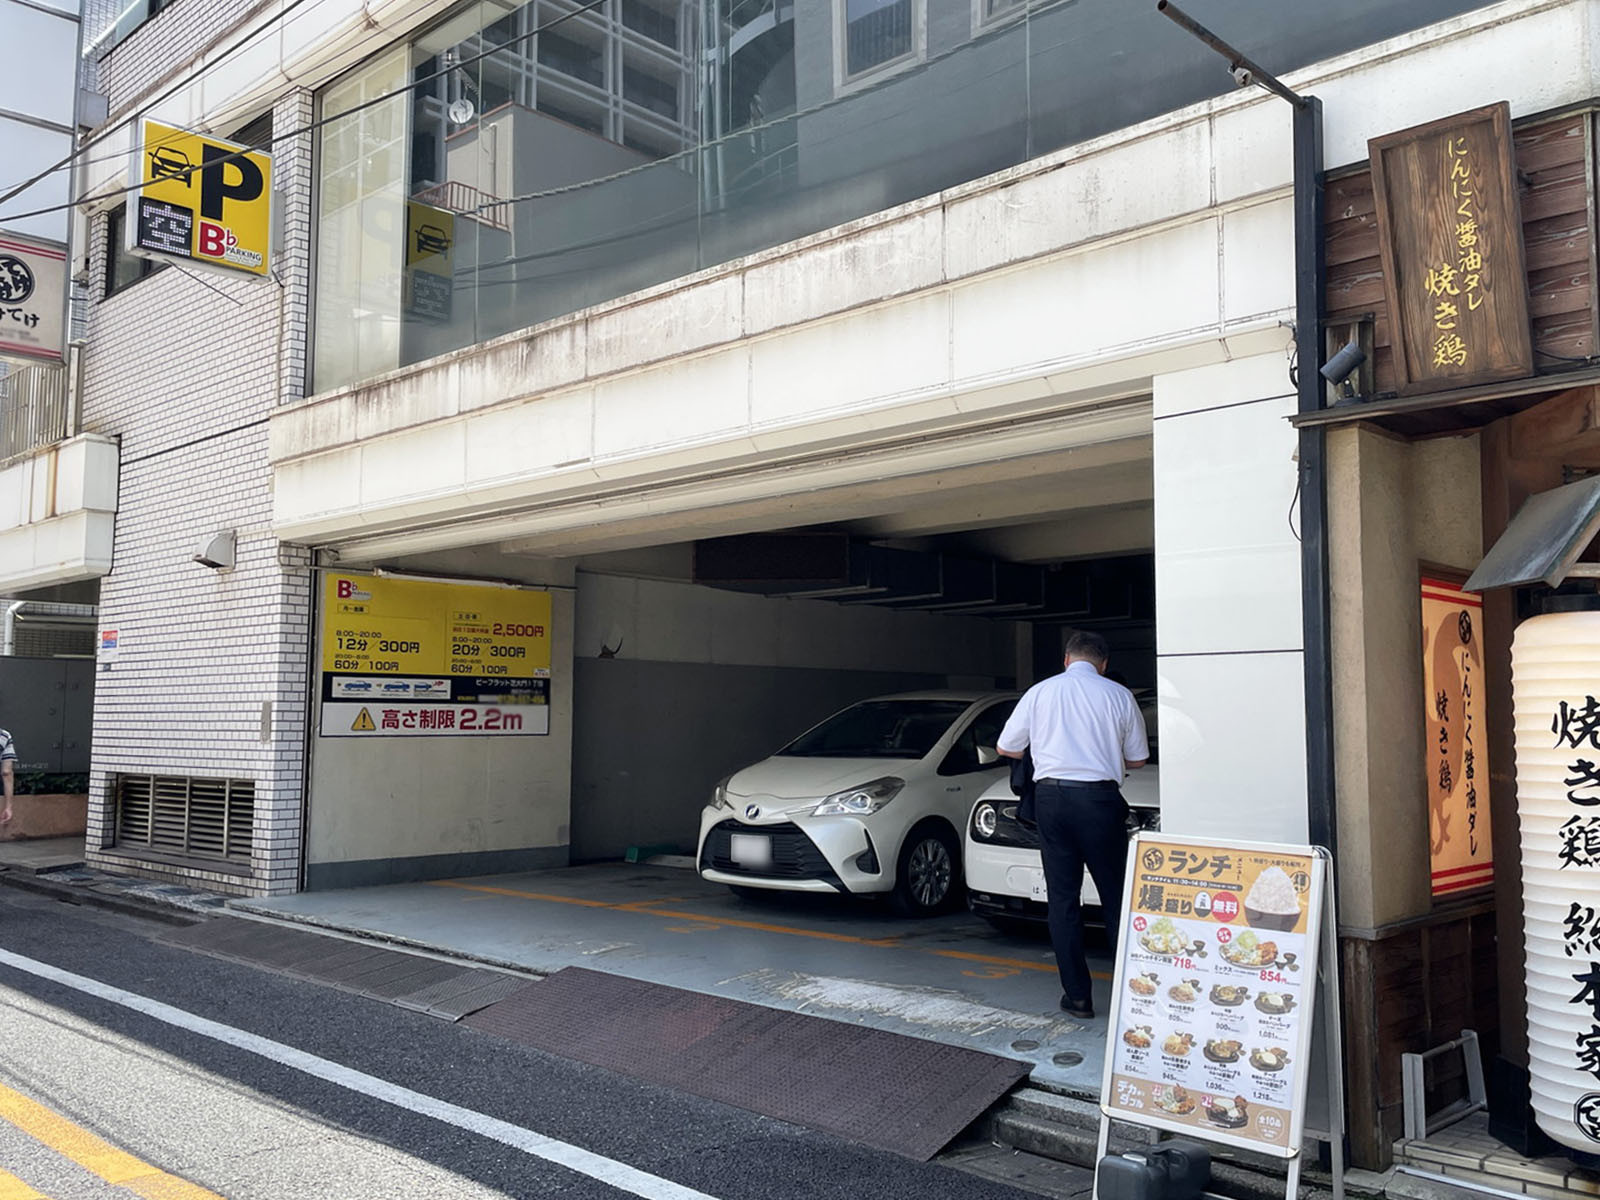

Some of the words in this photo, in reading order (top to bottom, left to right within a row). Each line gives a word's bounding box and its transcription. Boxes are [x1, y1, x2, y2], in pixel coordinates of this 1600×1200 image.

[200, 143, 264, 221] P
[142, 204, 192, 257] 空
[226, 246, 262, 261] PARKING
[1448, 137, 1484, 311] にんにく醤油ダレ
[1424, 263, 1468, 368] 焼き鶏
[493, 623, 544, 638] 2,500円
[1434, 688, 1453, 793] 焼き鶏
[1460, 652, 1478, 857] にんにく醤油ダレ
[1168, 850, 1232, 878] ランチ
